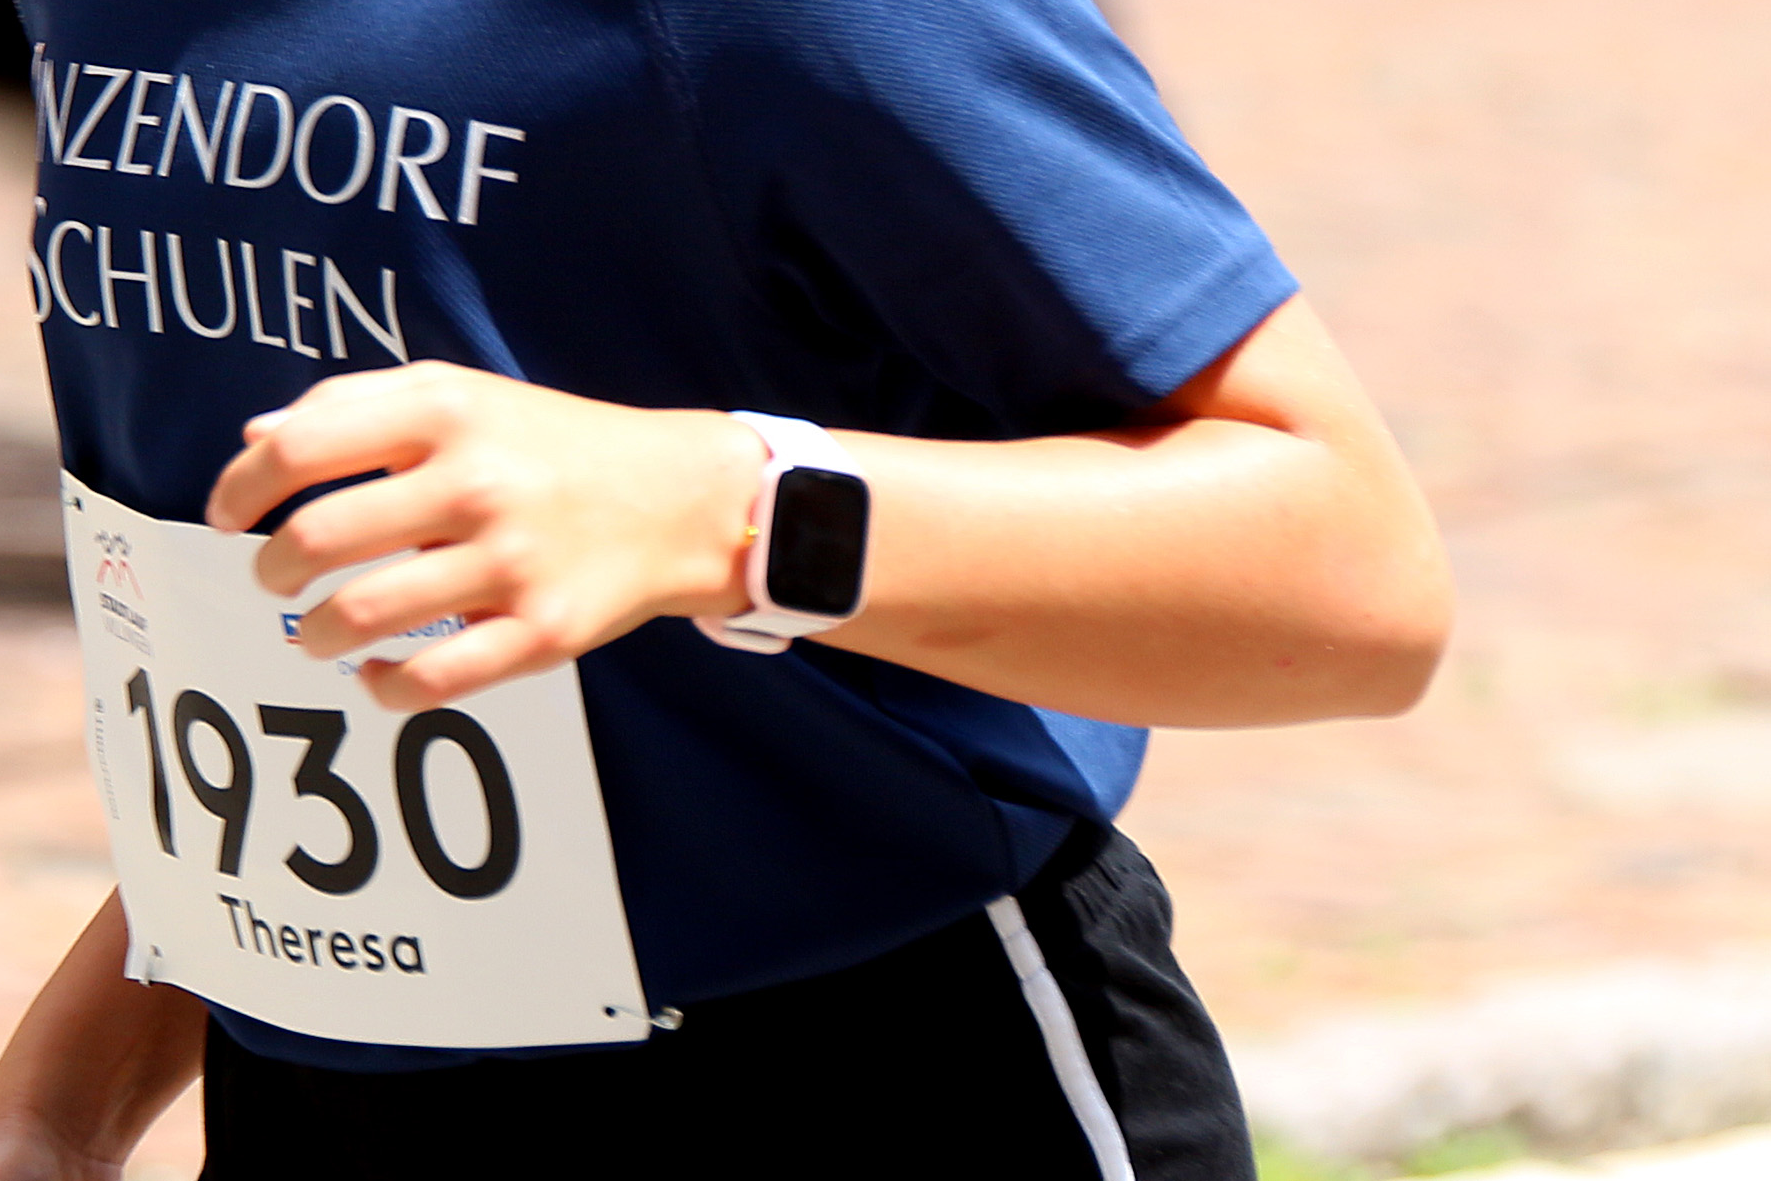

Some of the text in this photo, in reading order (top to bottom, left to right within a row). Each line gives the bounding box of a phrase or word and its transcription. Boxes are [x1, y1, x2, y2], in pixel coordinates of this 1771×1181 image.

[31, 42, 527, 226] NZENDORF
[126, 667, 522, 901] 1930
[218, 893, 427, 975] Theresa
